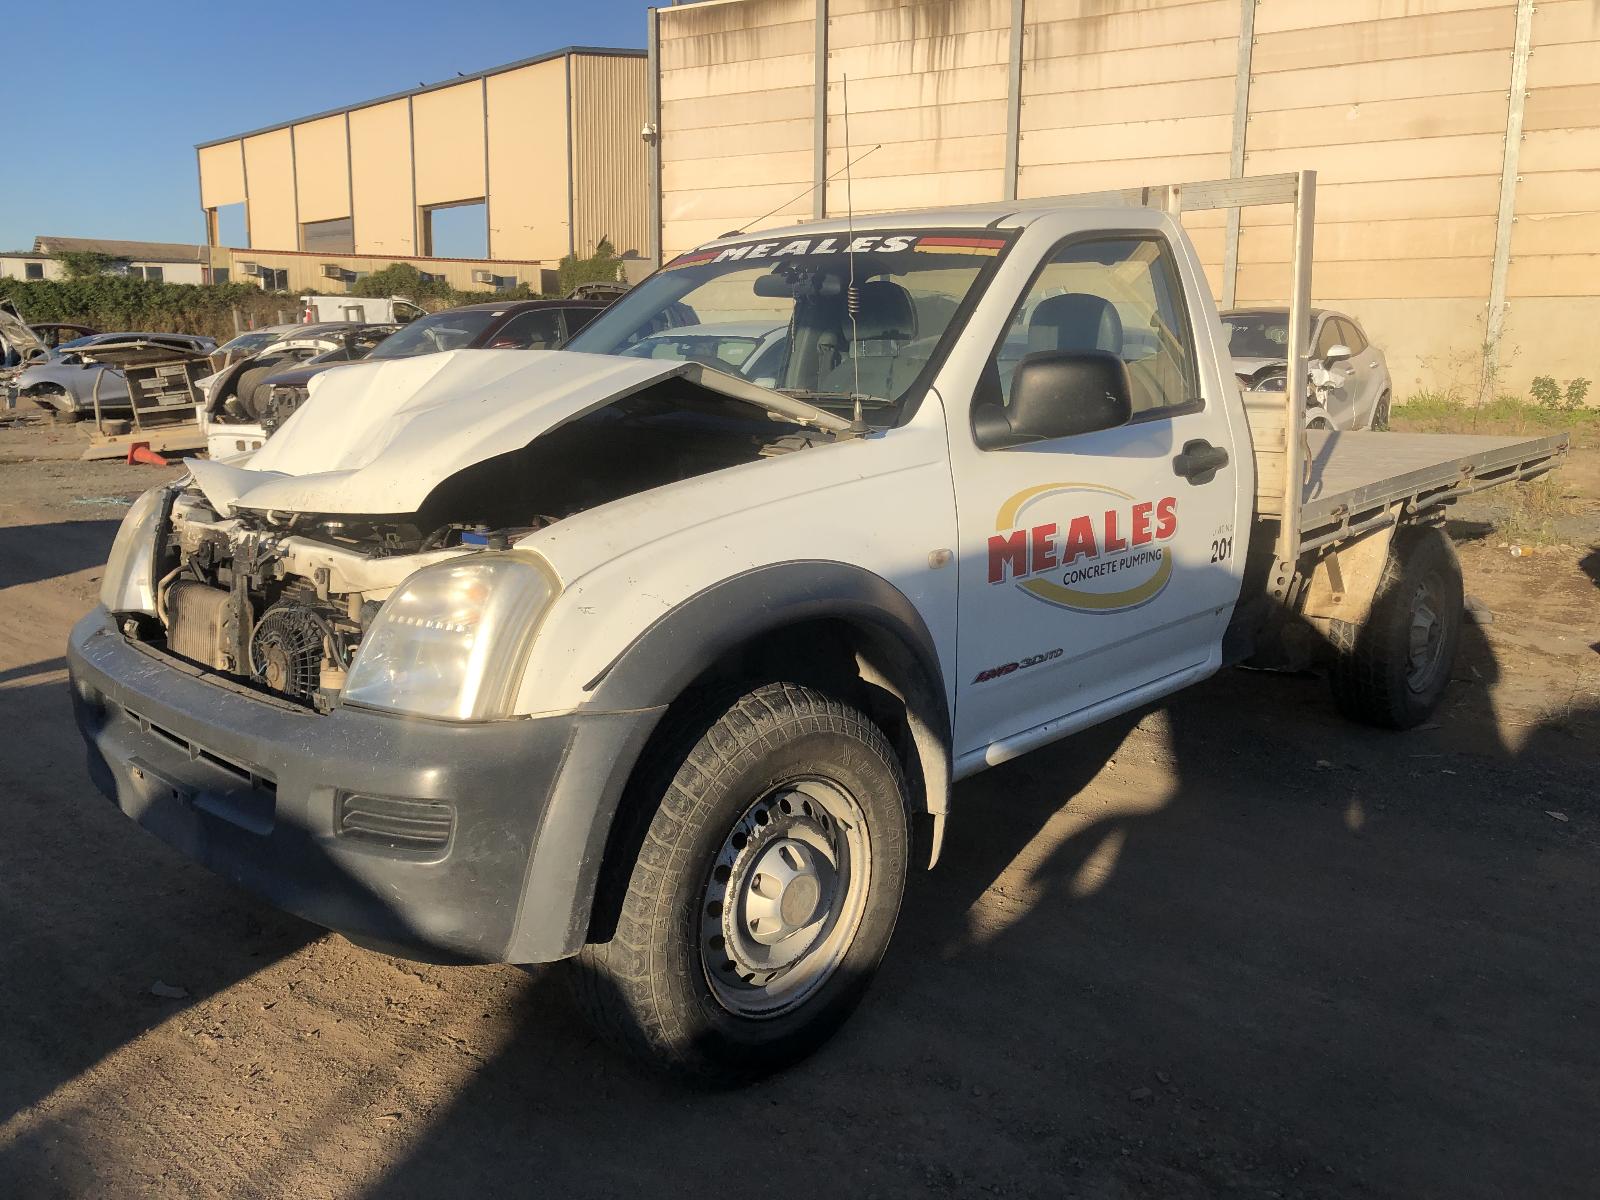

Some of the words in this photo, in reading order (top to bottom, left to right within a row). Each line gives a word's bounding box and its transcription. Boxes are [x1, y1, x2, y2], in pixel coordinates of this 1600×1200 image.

[711, 236, 918, 264] MEALES
[987, 496, 1178, 584] MEALES
[1210, 536, 1233, 564] 201
[1063, 560, 1117, 585] CONCRETE
[1119, 549, 1162, 571] PUMPING
